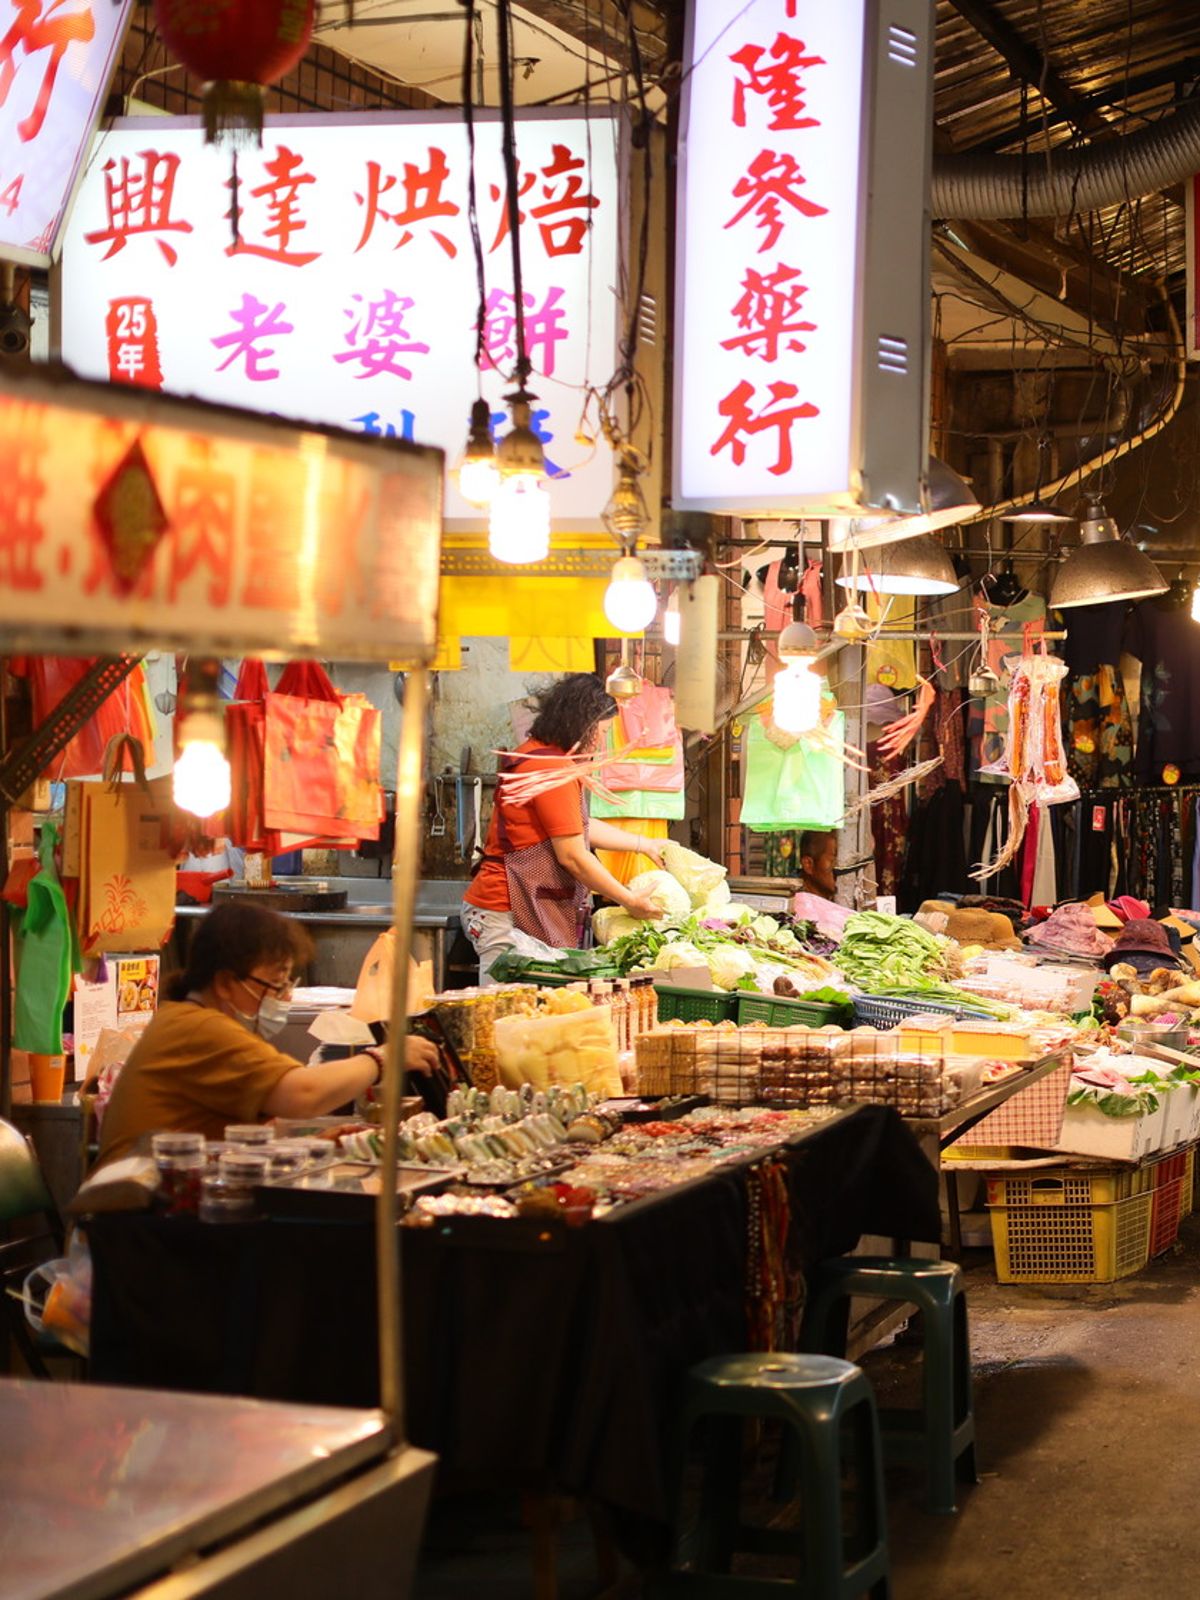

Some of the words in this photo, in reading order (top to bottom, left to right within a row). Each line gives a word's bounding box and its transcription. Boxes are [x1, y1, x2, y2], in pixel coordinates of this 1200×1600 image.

[83, 143, 601, 268] 興達烘焙
[710, 0, 829, 475] 隆參藥行
[210, 285, 570, 382] 老婆餅
